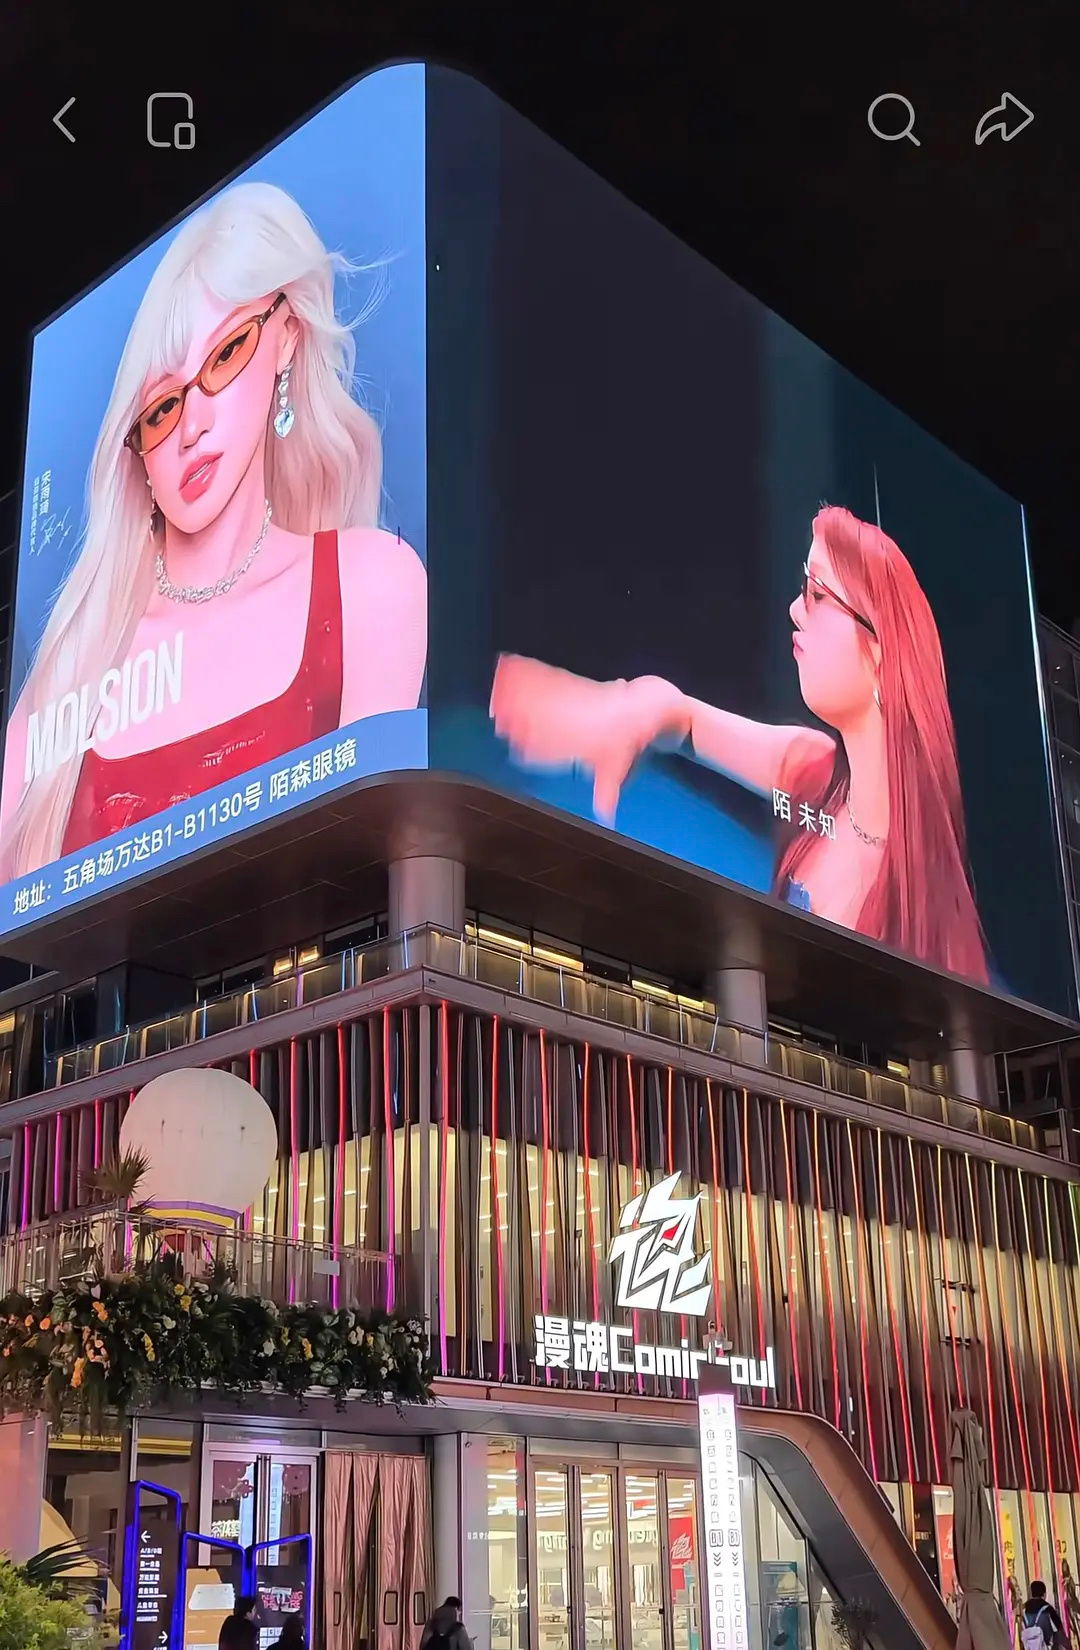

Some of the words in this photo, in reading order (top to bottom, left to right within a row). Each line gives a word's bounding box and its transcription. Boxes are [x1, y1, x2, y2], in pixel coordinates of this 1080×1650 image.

[25, 631, 183, 783] MOLSION
[270, 739, 357, 804] 陌森眼镜
